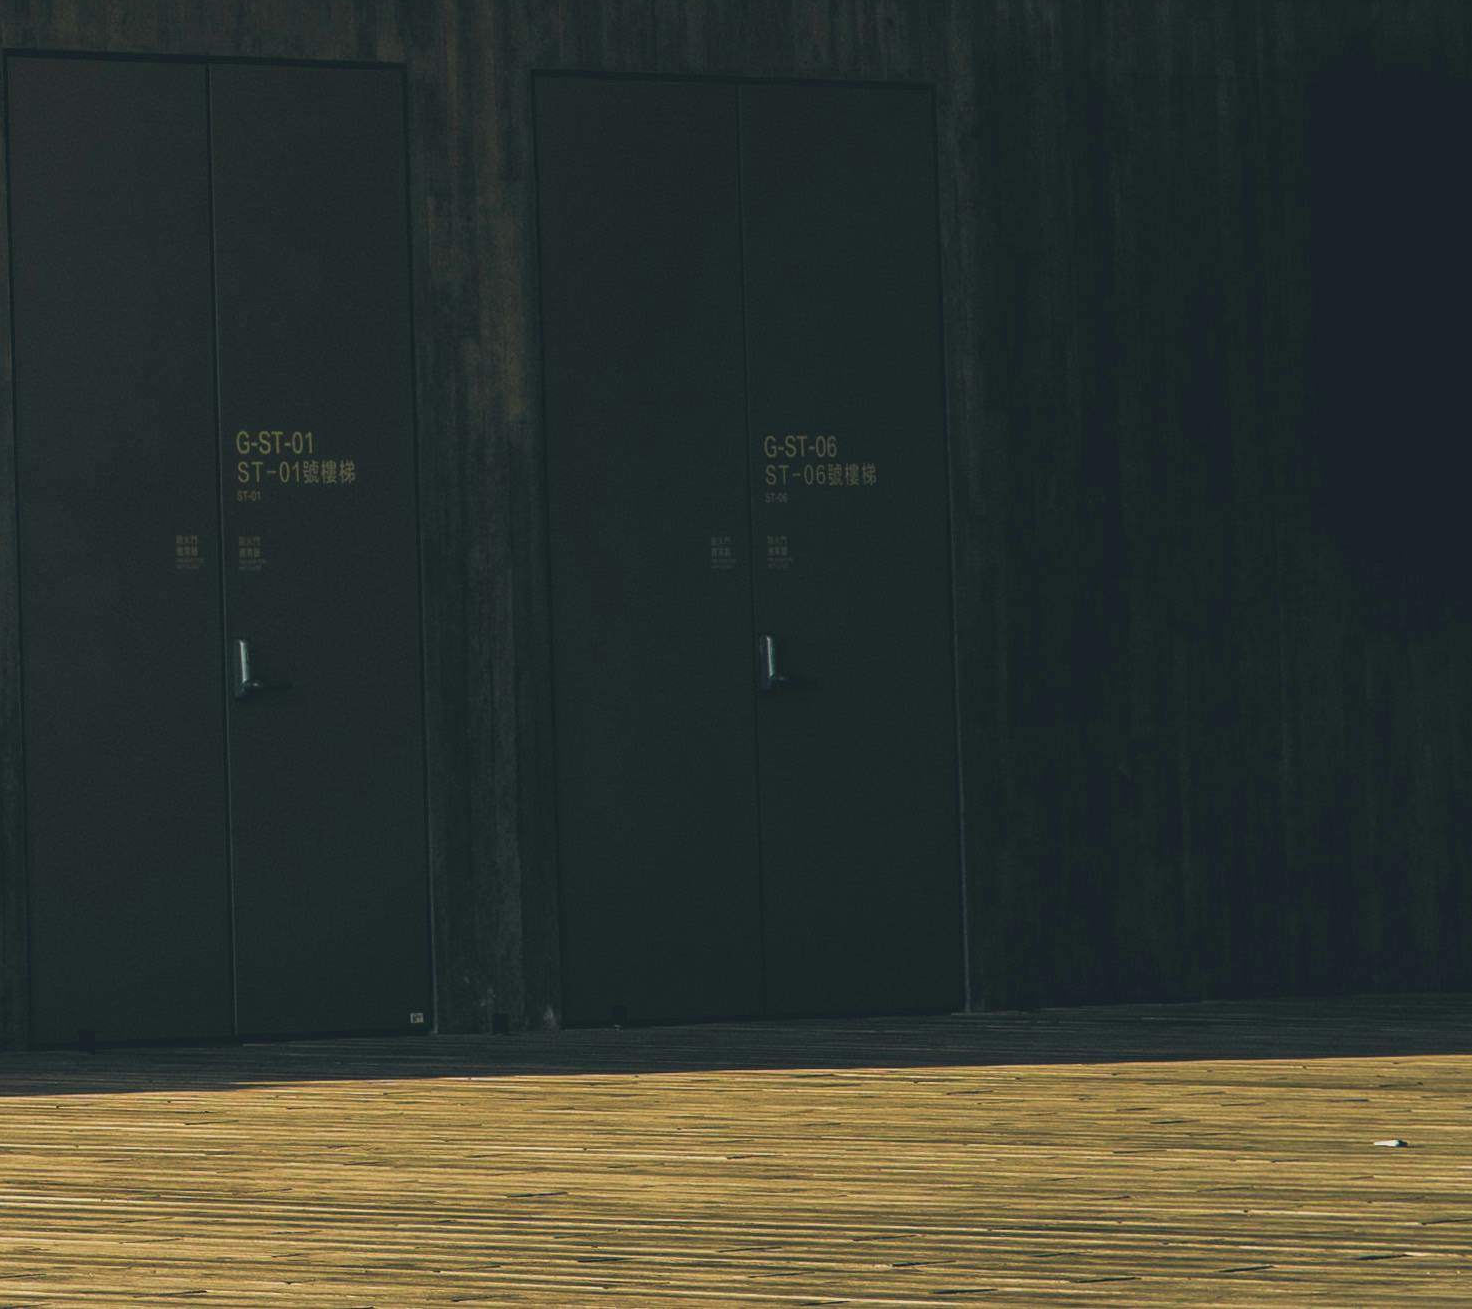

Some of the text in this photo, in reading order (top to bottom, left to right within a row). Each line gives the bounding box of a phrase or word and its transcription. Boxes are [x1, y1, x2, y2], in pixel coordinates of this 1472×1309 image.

[236, 431, 314, 454] G-ST-01
[764, 435, 837, 459] G-ST-06
[238, 460, 356, 484] ST-01號樓梯
[765, 463, 877, 487] ST-06號樓梯
[236, 491, 262, 502] ST-01
[765, 493, 788, 504] ST-06
